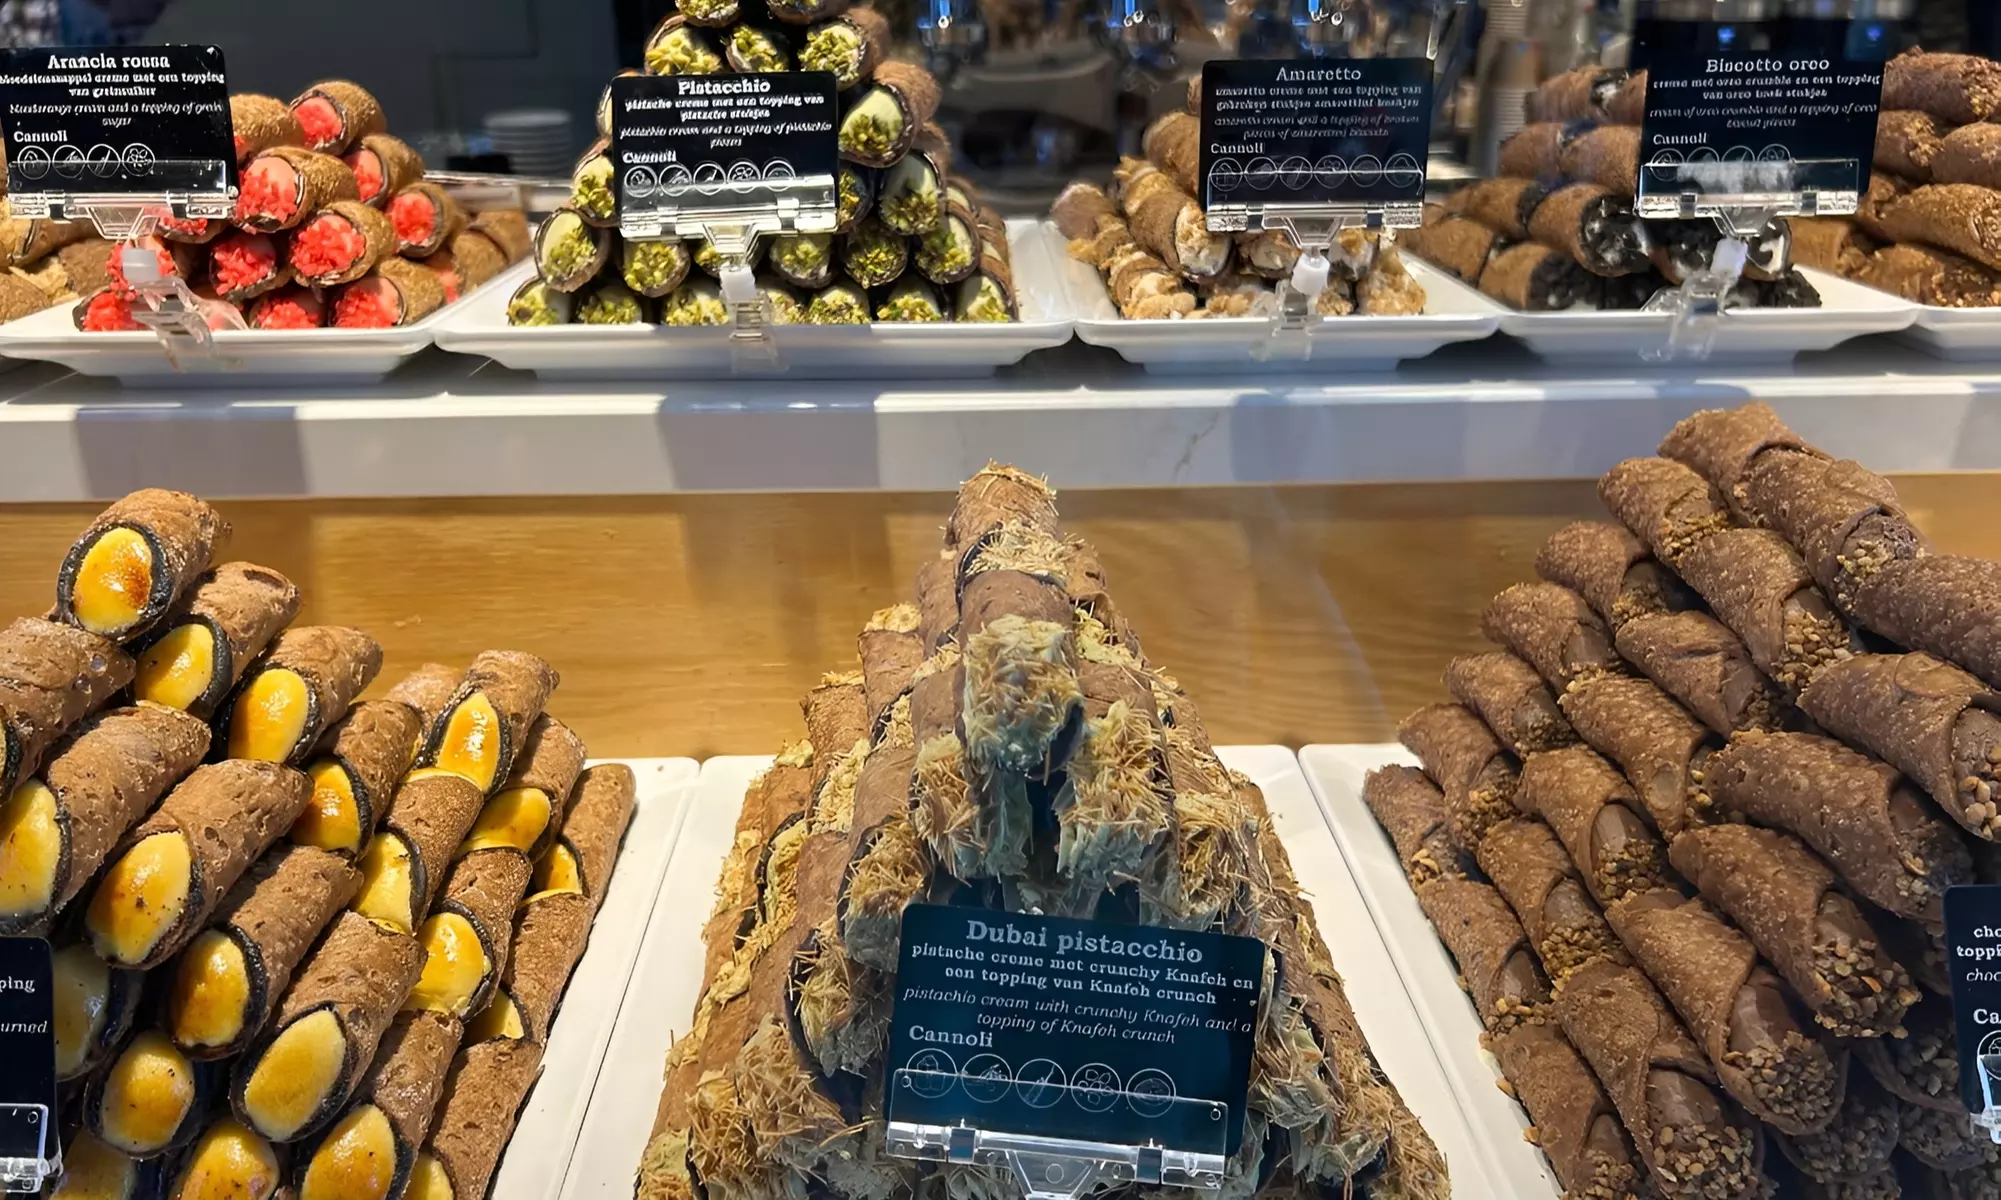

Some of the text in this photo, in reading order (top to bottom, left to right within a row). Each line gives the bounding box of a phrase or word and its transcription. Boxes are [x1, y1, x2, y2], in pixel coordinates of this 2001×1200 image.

[48, 54, 117, 69] Arancia
[1706, 59, 1782, 72] Biscotto
[1276, 67, 1362, 81] Amaretto
[678, 79, 770, 95] Pistacchio
[14, 130, 68, 142] Cannoli
[1653, 133, 1707, 144] Cannoli
[1211, 143, 1264, 154] Cannoli
[622, 150, 676, 163] Cannoli
[966, 920, 1202, 963] Dubai pistacchio
[912, 943, 1253, 990] pistache creme met crunchy Knafeh en
[945, 967, 1217, 1004] een topping van Knafeh crunch
[903, 986, 1251, 1033] pistachio cream with crunchy Knafeh and a
[977, 1012, 1176, 1044] topping of Knafeh crunch
[909, 1025, 993, 1048] Cannoli
